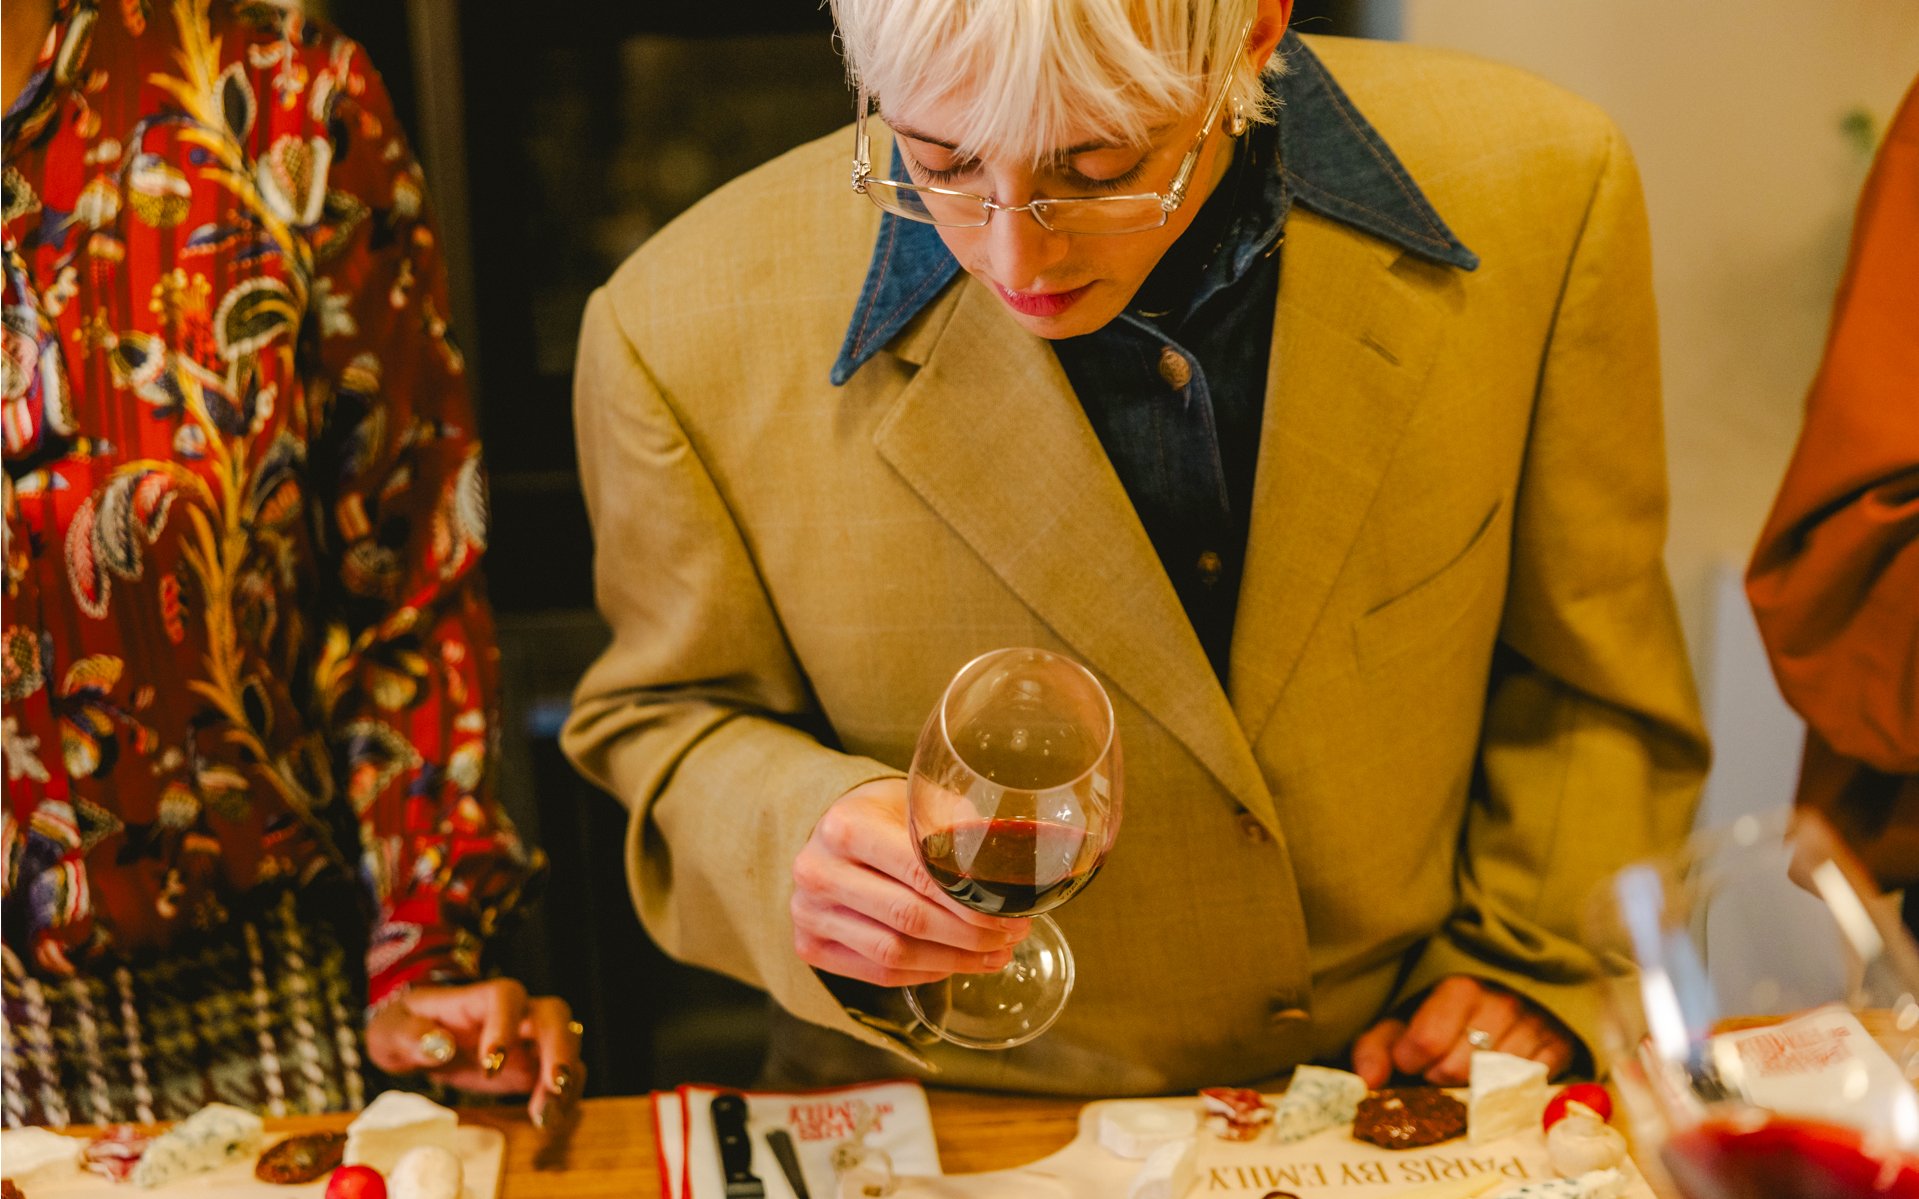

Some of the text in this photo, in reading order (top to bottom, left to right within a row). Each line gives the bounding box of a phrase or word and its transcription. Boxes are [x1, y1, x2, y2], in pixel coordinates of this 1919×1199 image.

[1208, 1155, 1531, 1191] PARIS BY EMILY
